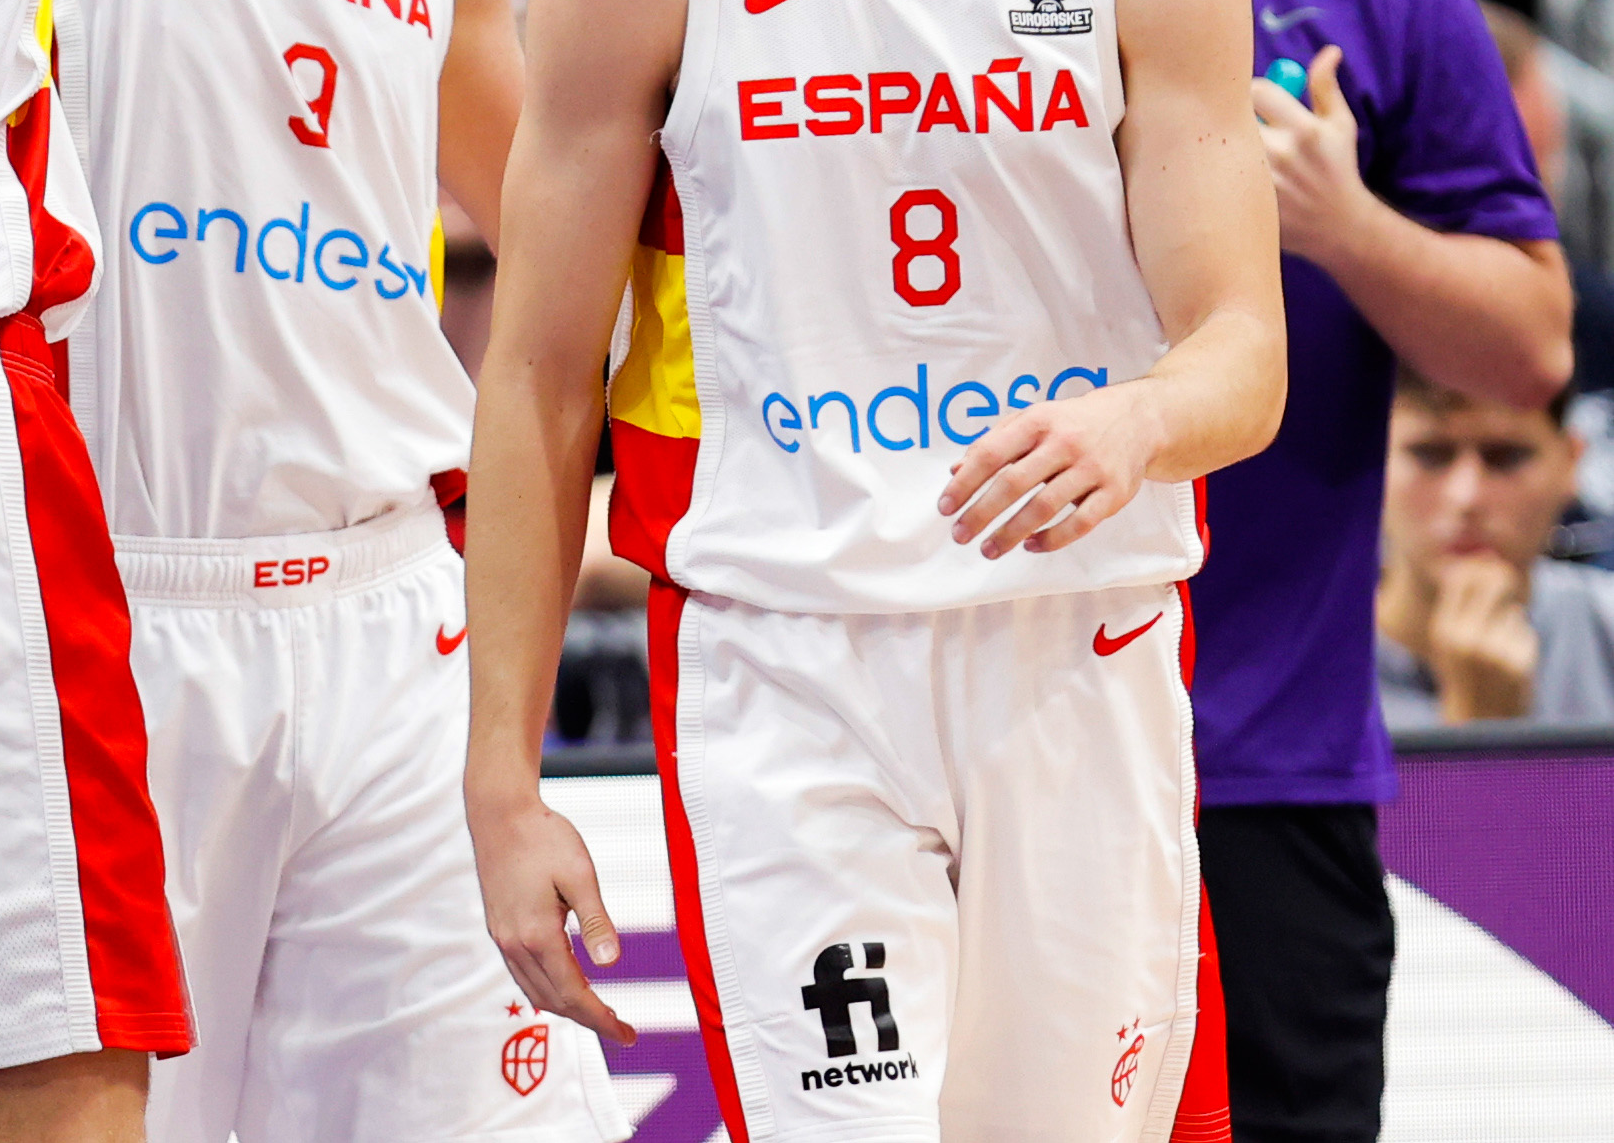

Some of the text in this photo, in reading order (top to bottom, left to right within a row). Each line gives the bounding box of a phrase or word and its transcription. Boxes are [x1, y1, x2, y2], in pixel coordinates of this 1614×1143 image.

[1011, 9, 1091, 28] EUROBASKET
[737, 57, 1090, 141] ESPAÑA
[889, 188, 962, 307] 8
[253, 556, 330, 588] ESP
[801, 942, 900, 1058] fi
[801, 1051, 920, 1091] network
